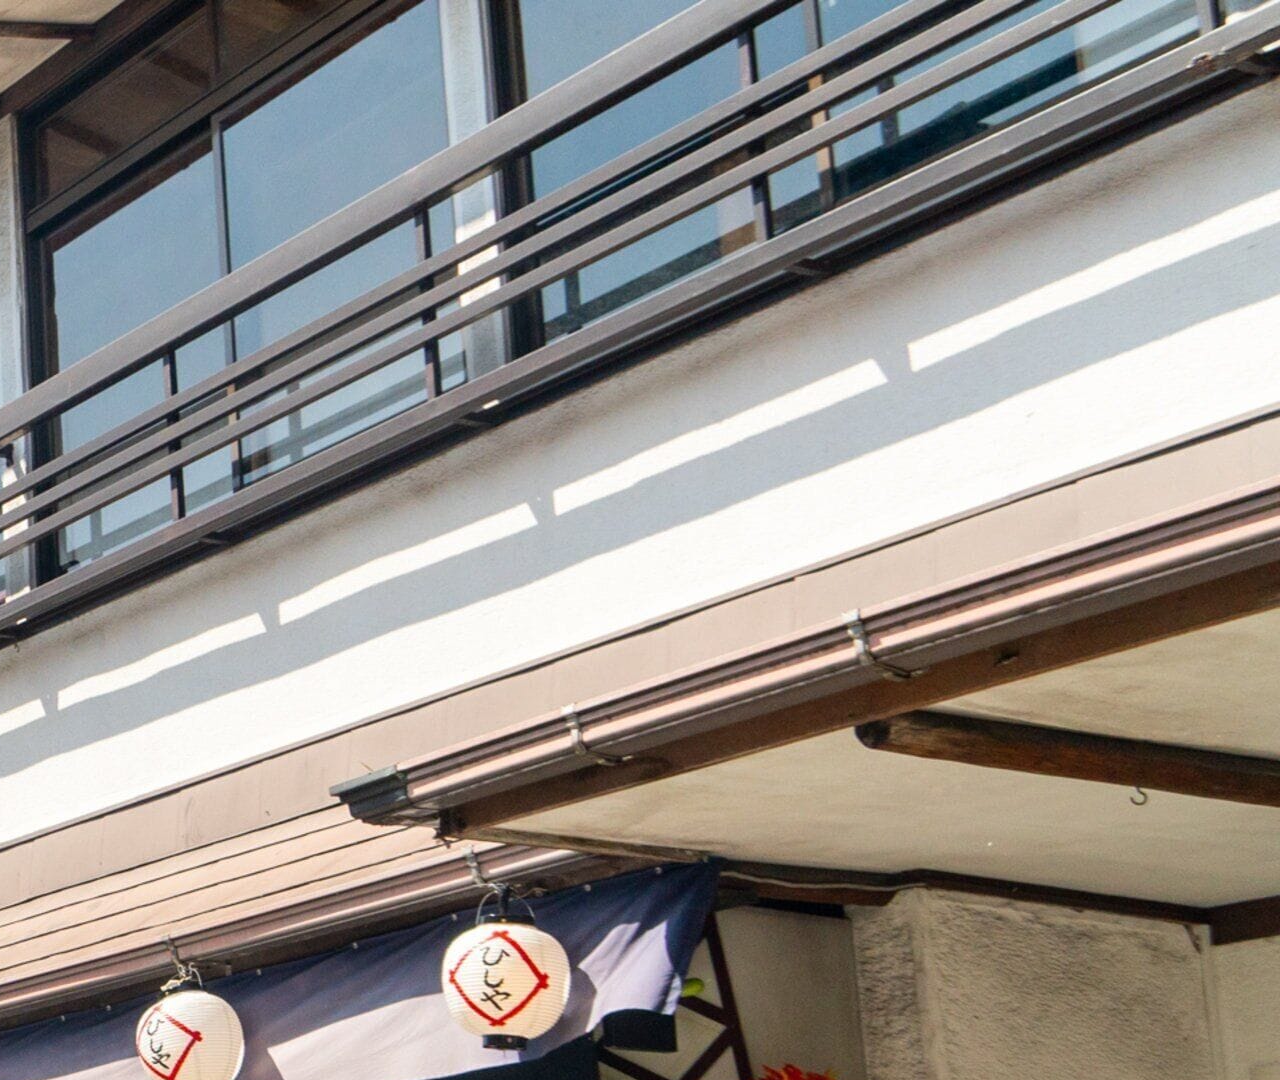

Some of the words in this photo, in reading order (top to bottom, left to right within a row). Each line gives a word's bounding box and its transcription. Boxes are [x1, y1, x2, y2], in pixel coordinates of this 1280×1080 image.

[479, 945, 511, 1011] ひしや
[145, 1016, 171, 1071] ひしや
